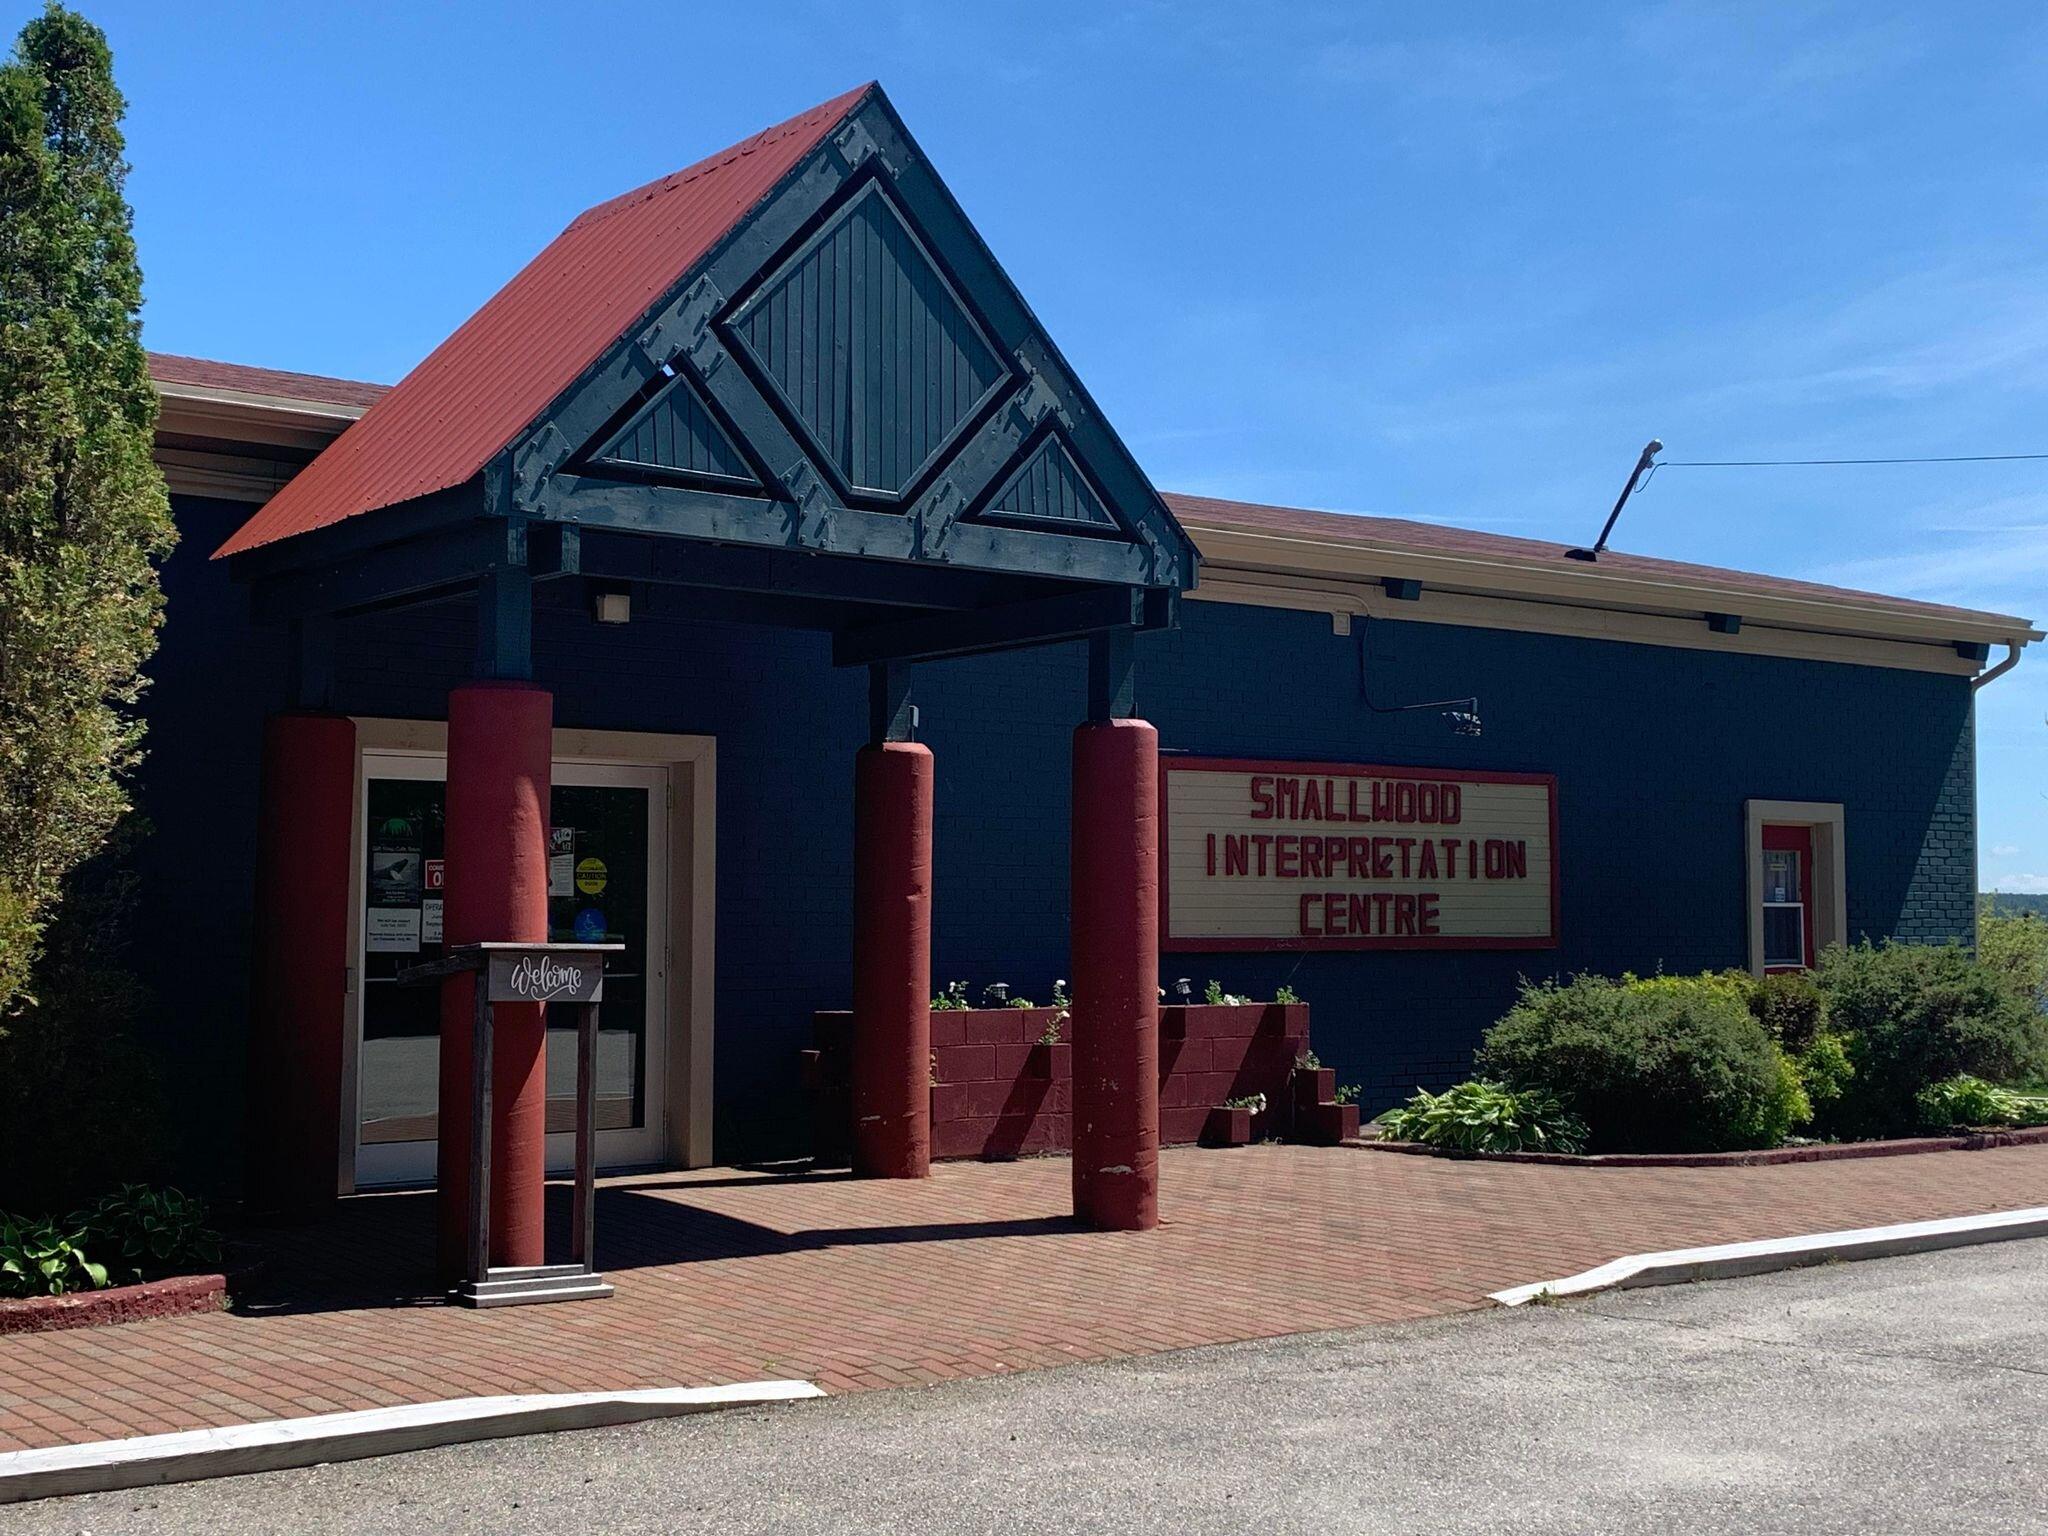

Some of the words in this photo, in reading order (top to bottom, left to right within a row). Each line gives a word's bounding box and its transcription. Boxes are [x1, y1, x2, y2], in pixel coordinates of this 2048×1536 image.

[1250, 777, 1461, 824] SMALLWOOD
[1206, 833, 1527, 880] INTERPRETATION
[1299, 893, 1441, 936] CENTRE
[511, 955, 582, 1001] Welcome
